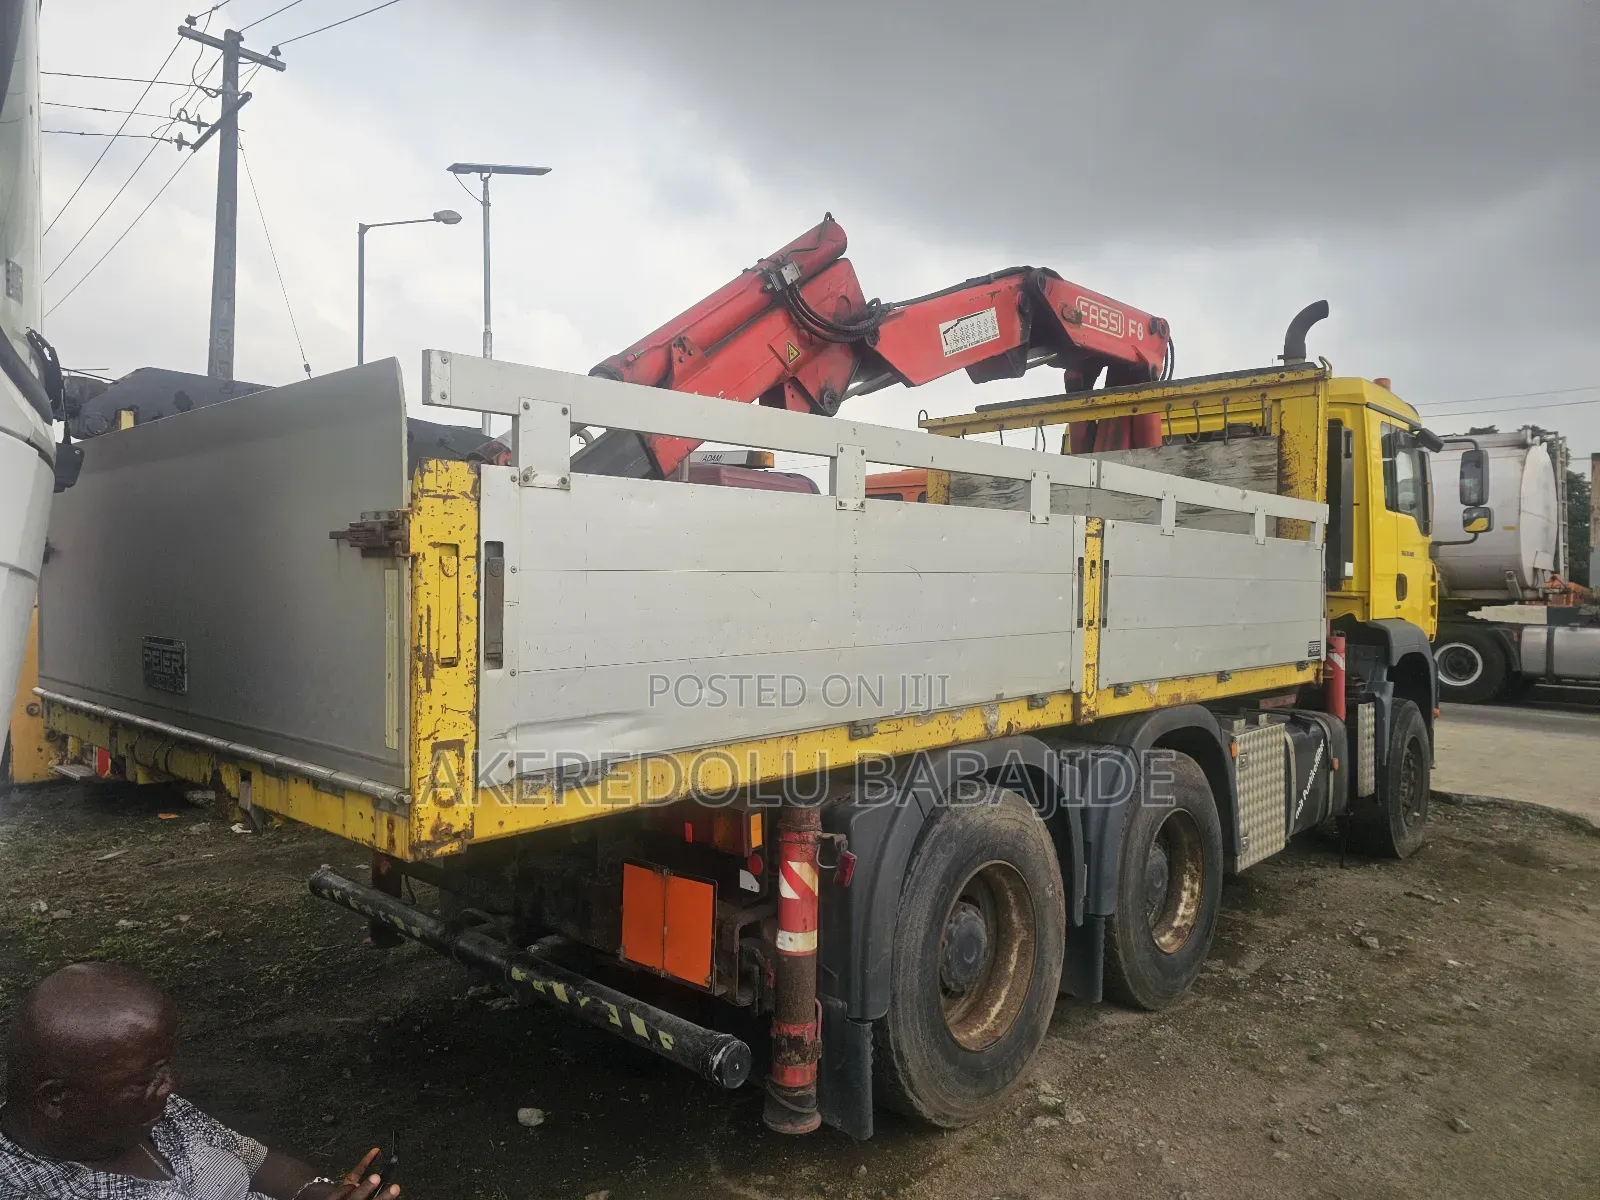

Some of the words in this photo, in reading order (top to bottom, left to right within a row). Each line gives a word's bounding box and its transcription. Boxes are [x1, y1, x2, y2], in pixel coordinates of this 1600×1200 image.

[1080, 301, 1121, 333] FASSI
[1128, 319, 1143, 340] F8
[702, 454, 722, 462] ADAM
